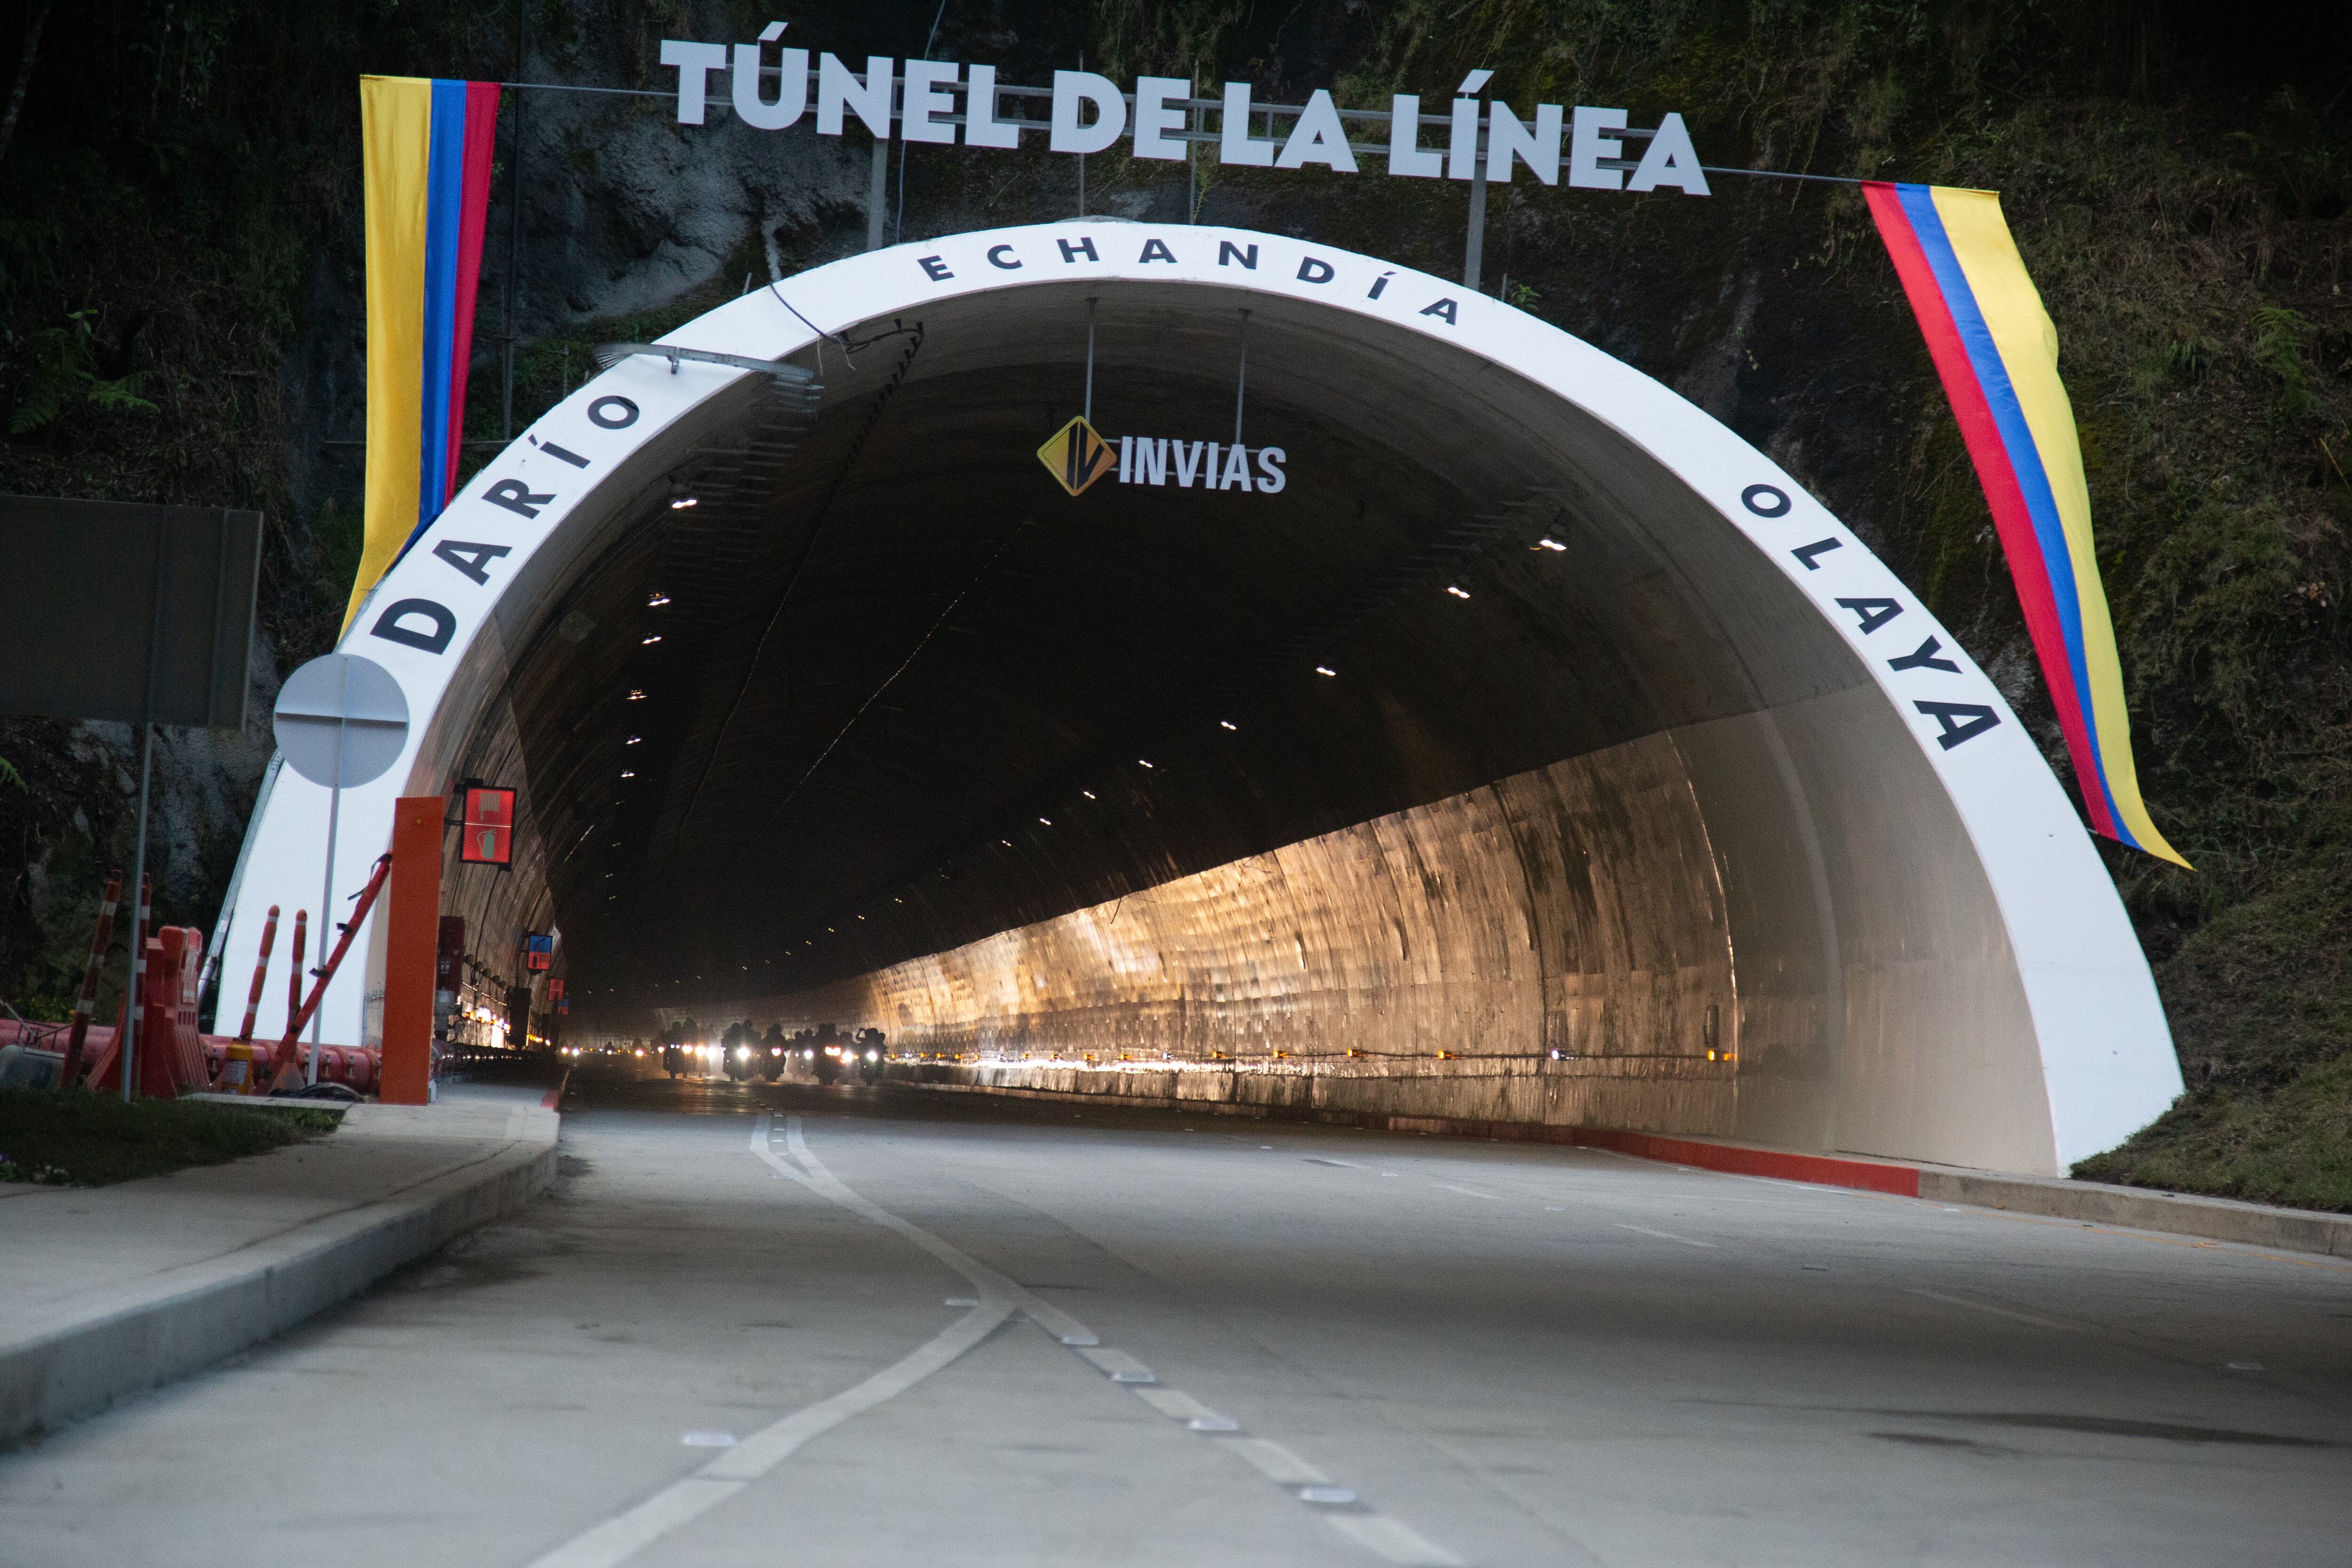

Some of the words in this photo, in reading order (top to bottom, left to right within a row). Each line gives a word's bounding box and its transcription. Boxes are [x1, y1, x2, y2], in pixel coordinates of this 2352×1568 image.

[660, 21, 1019, 149] TÚNEL
[1050, 70, 1191, 160] DE
[1221, 82, 1359, 172] LA
[1389, 69, 1710, 195] LÍNEA
[369, 395, 640, 656] DARÍO
[917, 237, 1458, 326] ECHANDÍA
[1740, 483, 2002, 752] OLAYA
[1119, 436, 1287, 494] INVIAS
